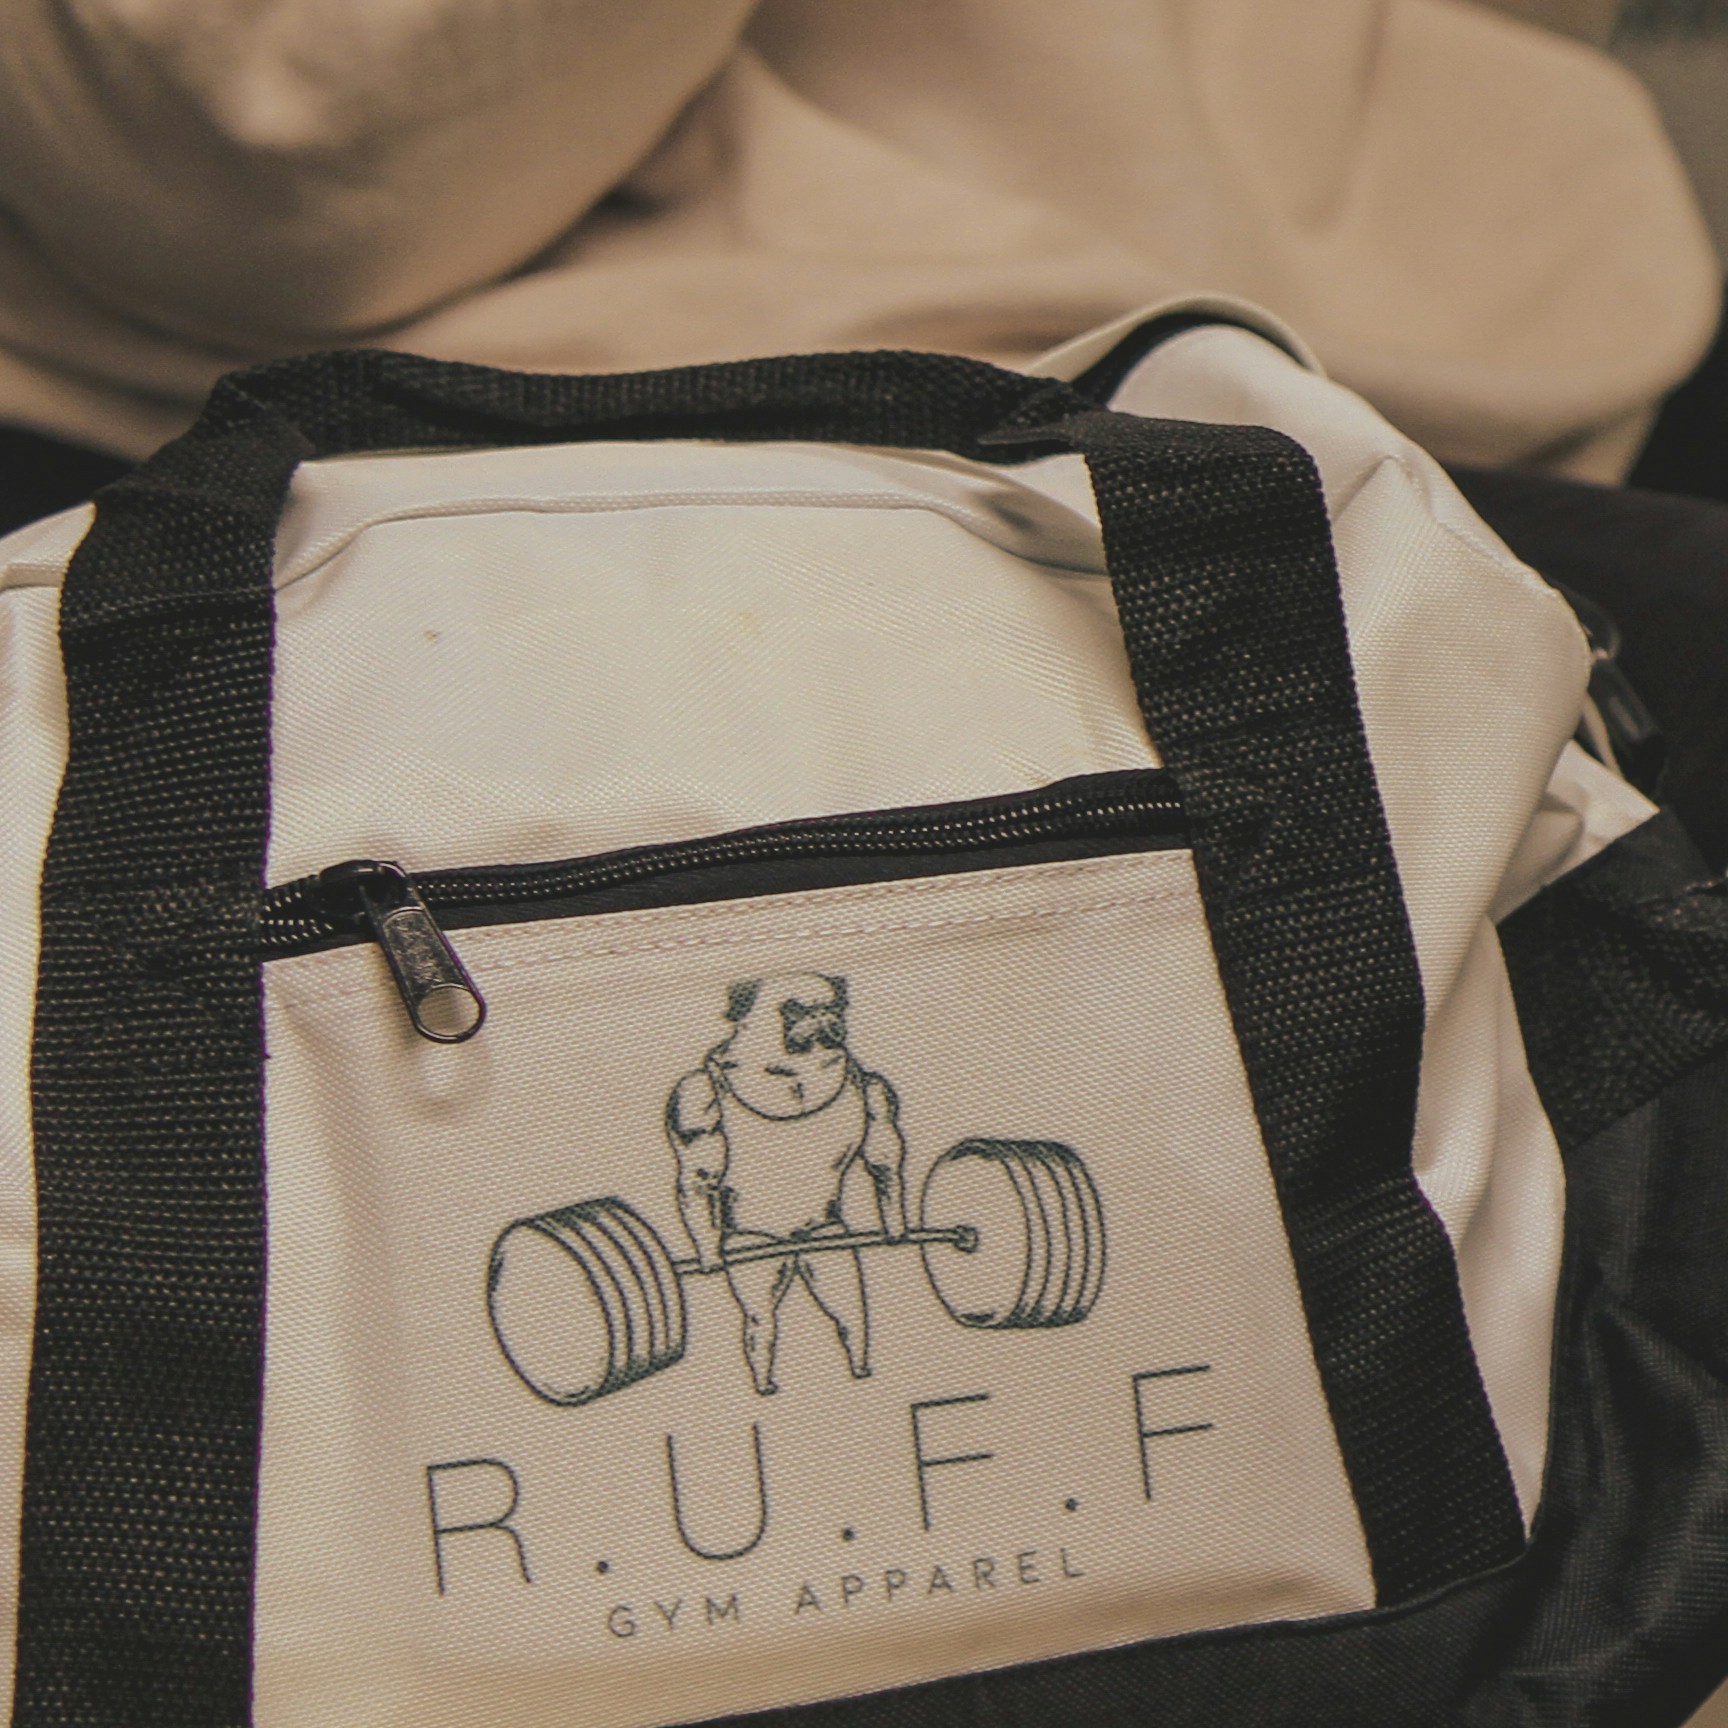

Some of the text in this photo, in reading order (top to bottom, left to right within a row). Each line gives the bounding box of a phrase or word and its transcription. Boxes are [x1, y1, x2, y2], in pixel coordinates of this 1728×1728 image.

[425, 1365, 1215, 1596] R.U.F.F
[607, 1545, 1085, 1639] GYM APPAREL
